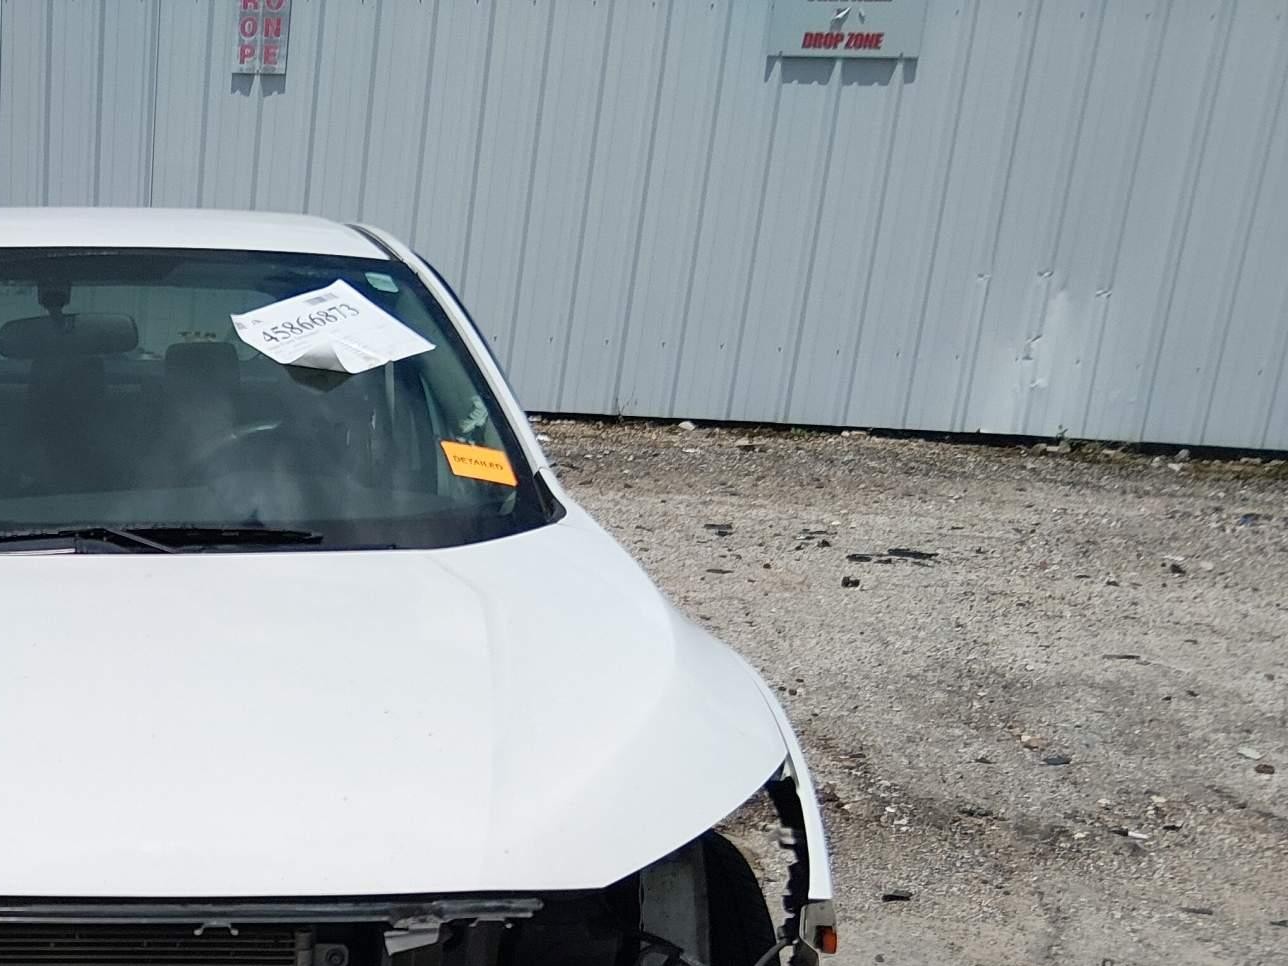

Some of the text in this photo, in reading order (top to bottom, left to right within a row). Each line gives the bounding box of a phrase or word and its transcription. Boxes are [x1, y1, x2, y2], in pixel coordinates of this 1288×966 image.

[801, 32, 885, 49] DROP ZONE
[261, 303, 360, 343] 45866873
